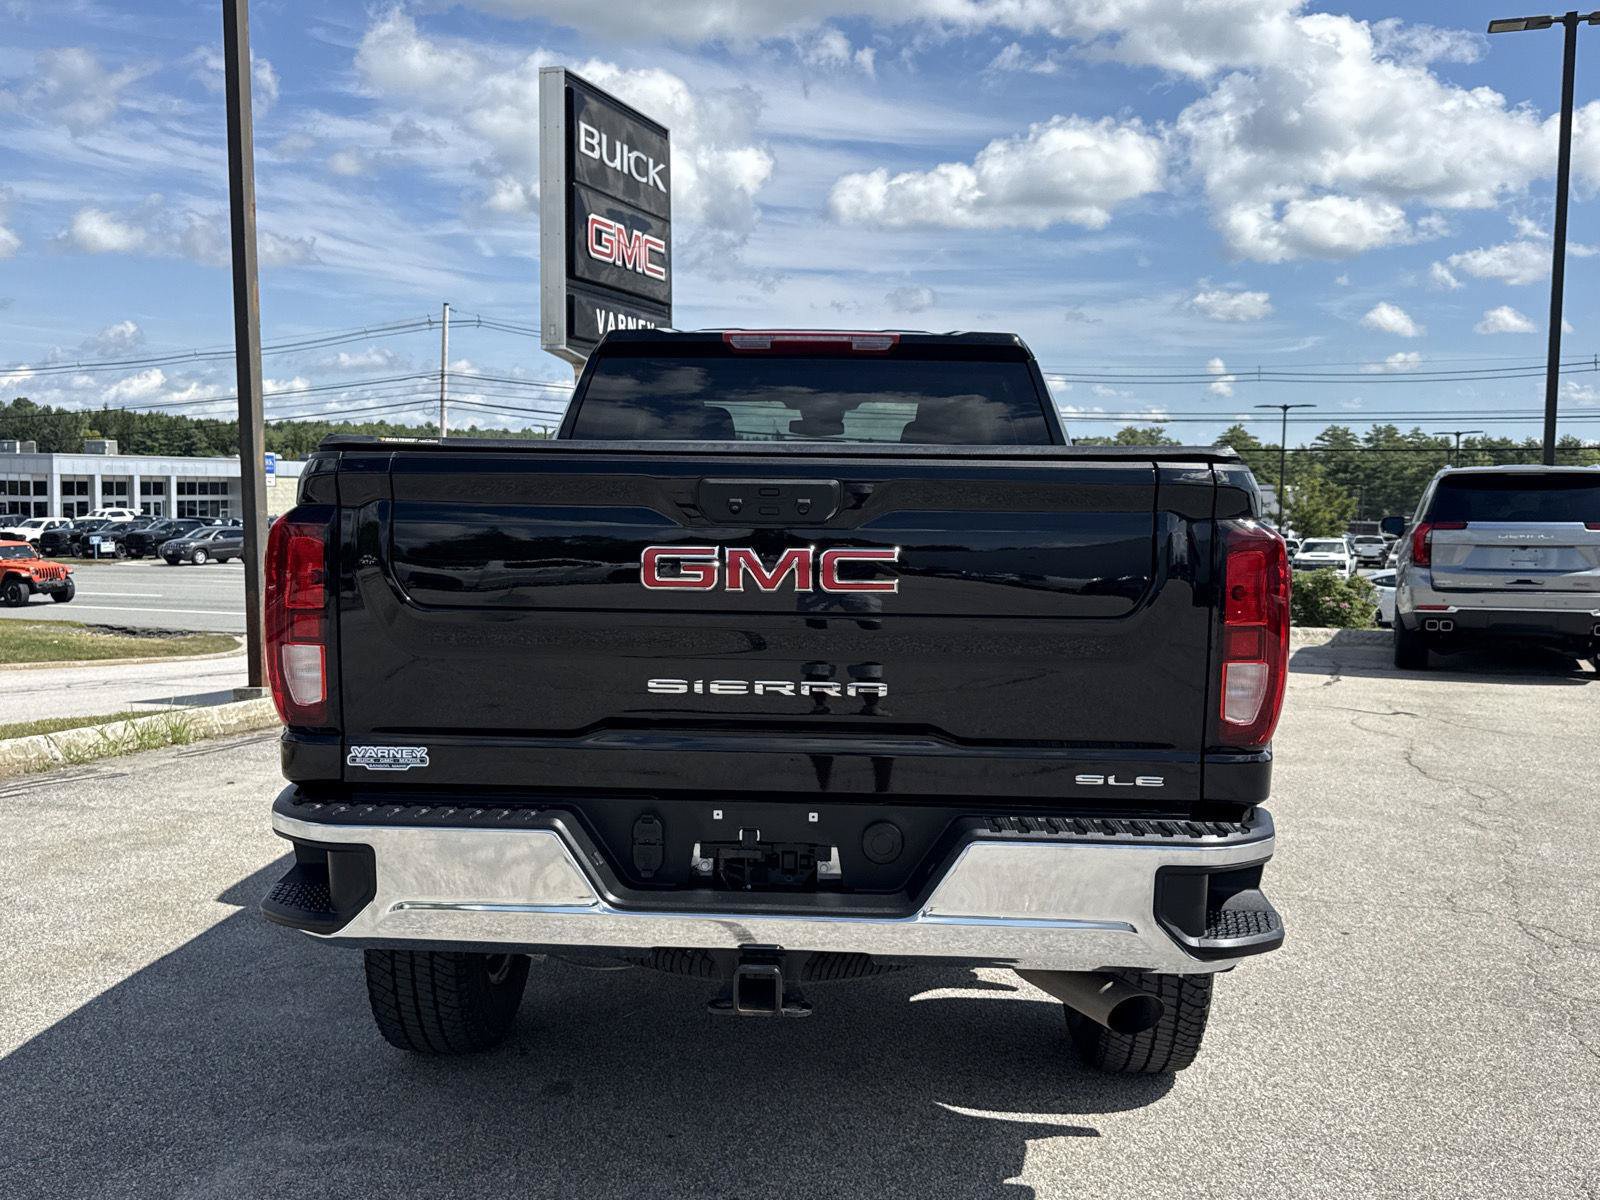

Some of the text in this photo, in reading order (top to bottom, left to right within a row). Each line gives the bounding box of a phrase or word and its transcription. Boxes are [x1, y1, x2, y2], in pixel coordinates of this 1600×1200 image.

[579, 121, 667, 193] BUICK
[588, 213, 666, 281] GMC
[640, 545, 900, 593] GMC
[647, 679, 889, 697] SIERRA
[353, 749, 424, 758] VARNEY
[1075, 774, 1165, 787] SLE
